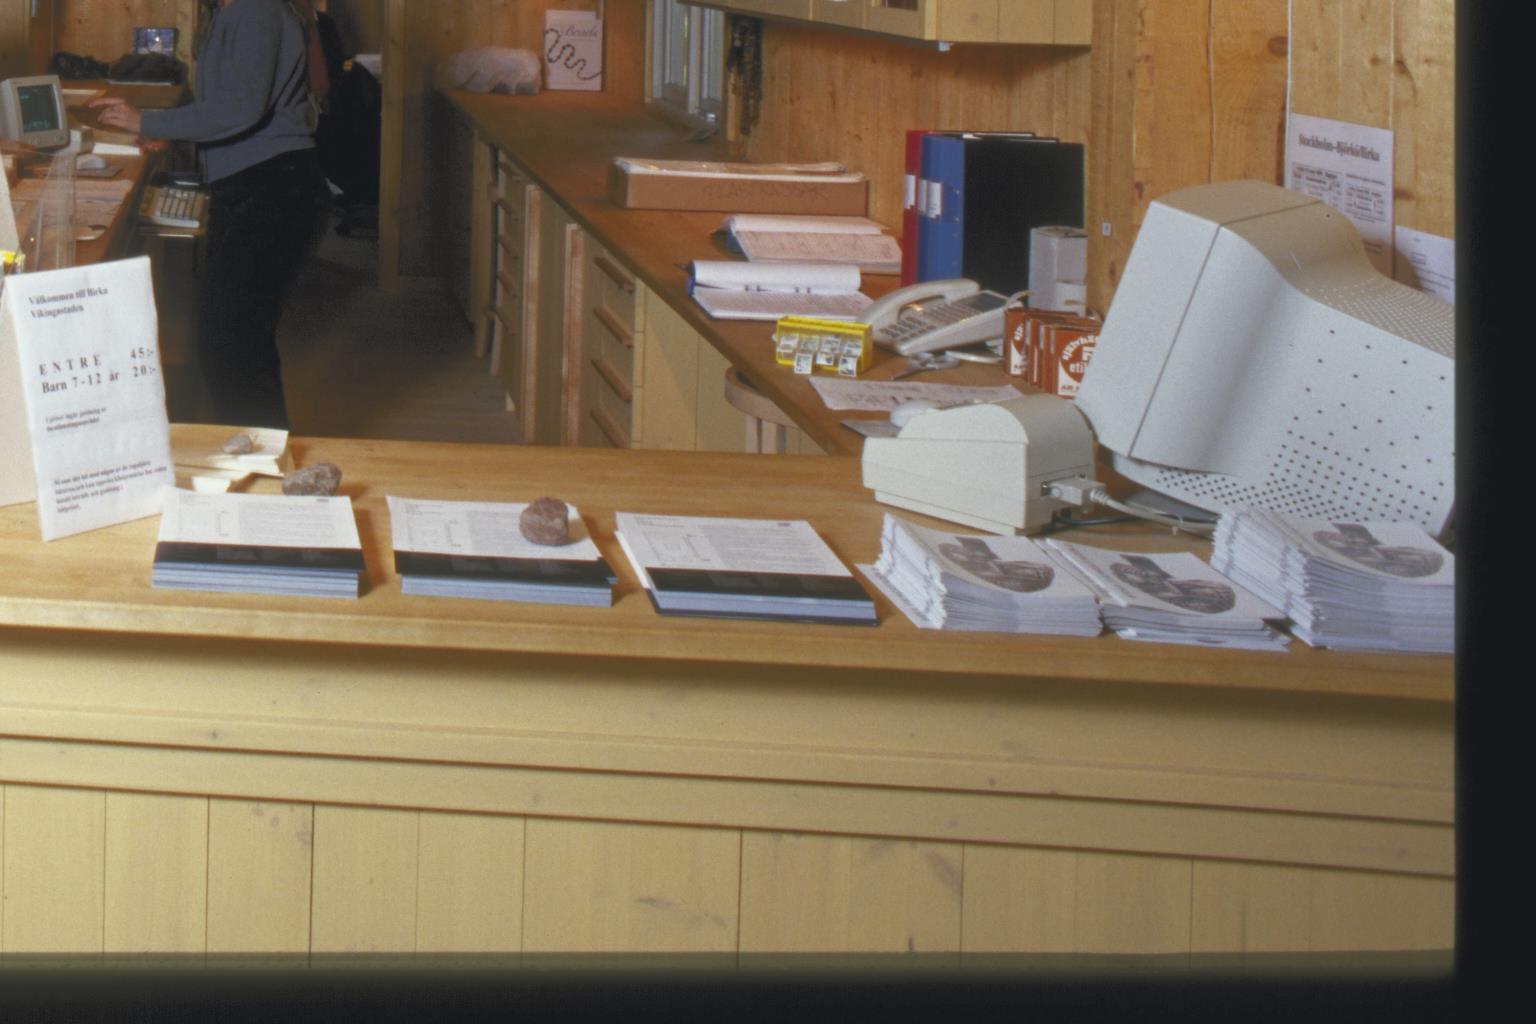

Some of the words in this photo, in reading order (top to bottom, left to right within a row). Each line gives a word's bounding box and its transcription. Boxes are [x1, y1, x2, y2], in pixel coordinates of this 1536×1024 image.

[28, 292, 75, 306] Välkommen
[75, 288, 86, 299] till
[87, 287, 109, 298] Birka
[42, 380, 67, 394] Barn
[72, 373, 102, 387] 7-12
[109, 369, 121, 381] år
